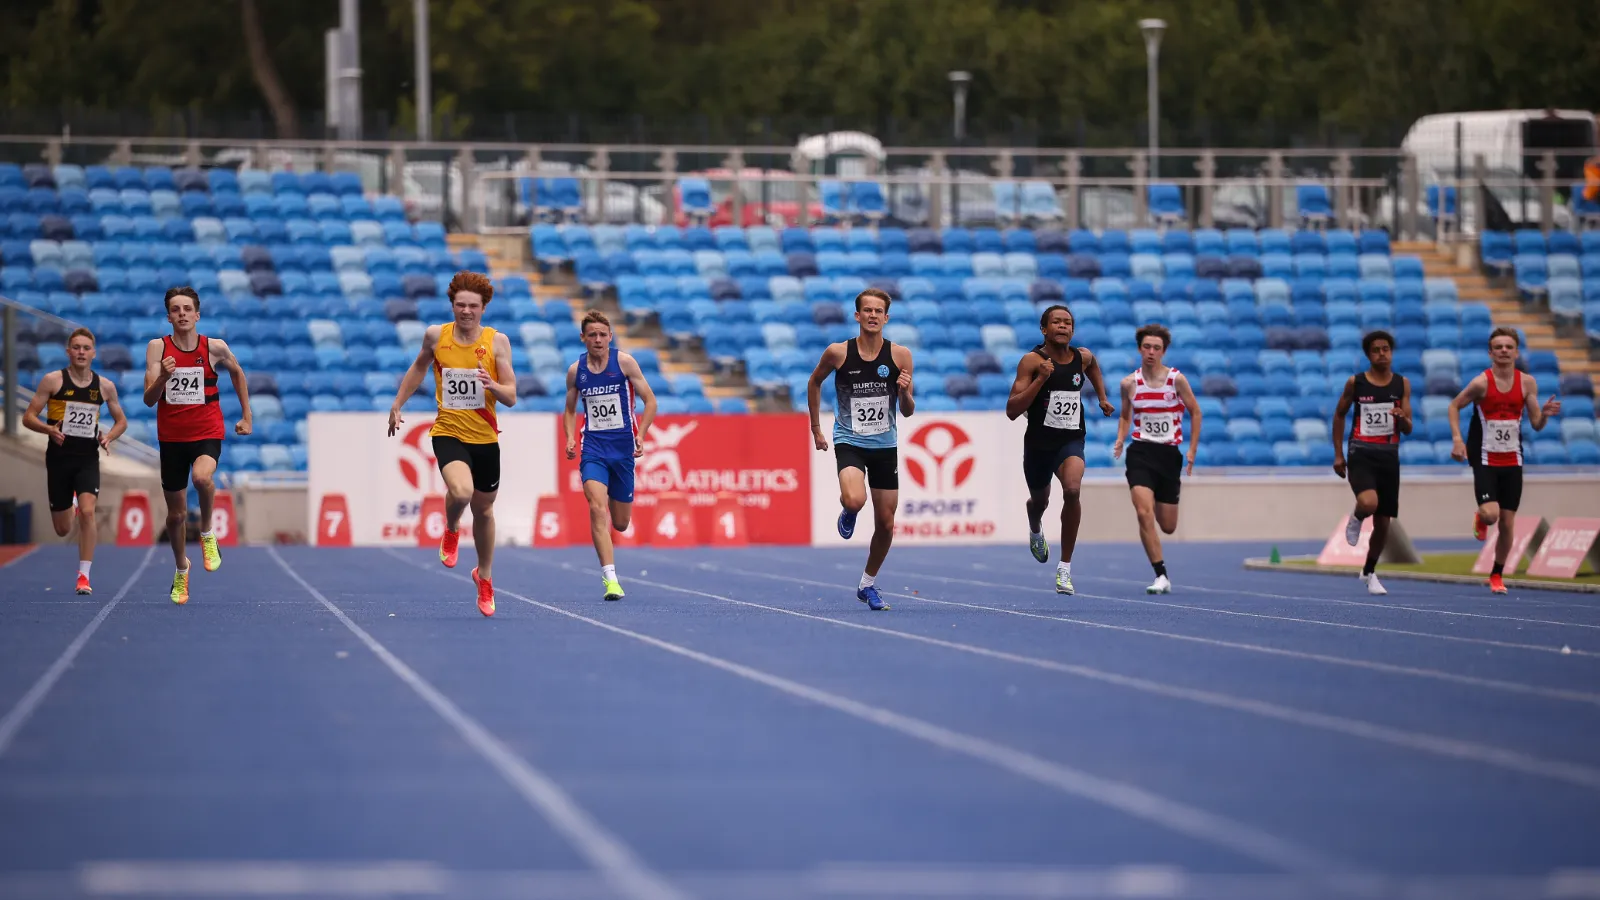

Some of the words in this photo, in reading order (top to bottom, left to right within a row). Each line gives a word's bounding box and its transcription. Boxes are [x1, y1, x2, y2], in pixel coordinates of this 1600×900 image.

[170, 377, 199, 391] 294
[447, 380, 477, 395] 301
[581, 384, 621, 396] CARDIFF
[852, 382, 887, 390] BURTON
[591, 403, 617, 418] 304
[857, 407, 884, 422] 326
[1053, 401, 1078, 416] 329
[68, 411, 93, 426] 223
[1365, 412, 1388, 425] 321
[1145, 421, 1169, 433] 330
[1495, 429, 1511, 441] 36
[683, 469, 799, 492] ATHLETICS
[903, 499, 977, 515] SPORT
[125, 507, 145, 539] 9
[211, 508, 229, 539] 8
[324, 510, 344, 538] 7
[425, 511, 445, 539] 6
[540, 511, 560, 539] 5
[657, 511, 679, 539] 4
[719, 511, 736, 539] 1
